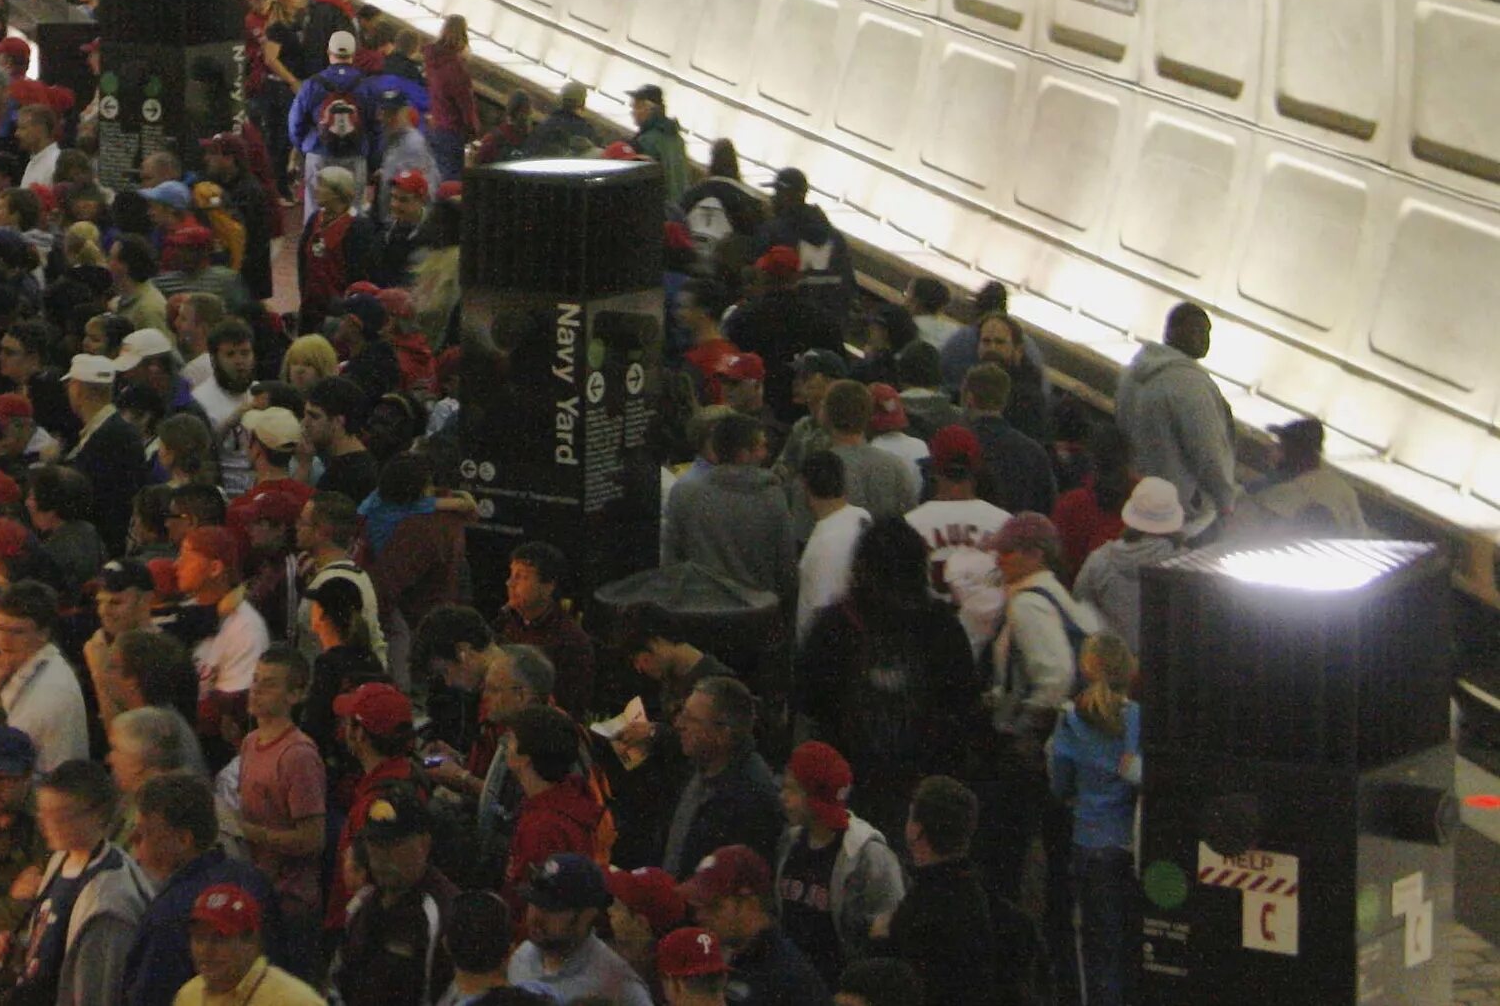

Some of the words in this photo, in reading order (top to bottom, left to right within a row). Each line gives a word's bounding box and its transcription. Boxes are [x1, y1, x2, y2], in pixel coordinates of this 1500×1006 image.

[553, 302, 581, 383] Navy
[555, 397, 580, 466] Yard
[1222, 853, 1274, 871] HELP
[697, 934, 712, 954] P
